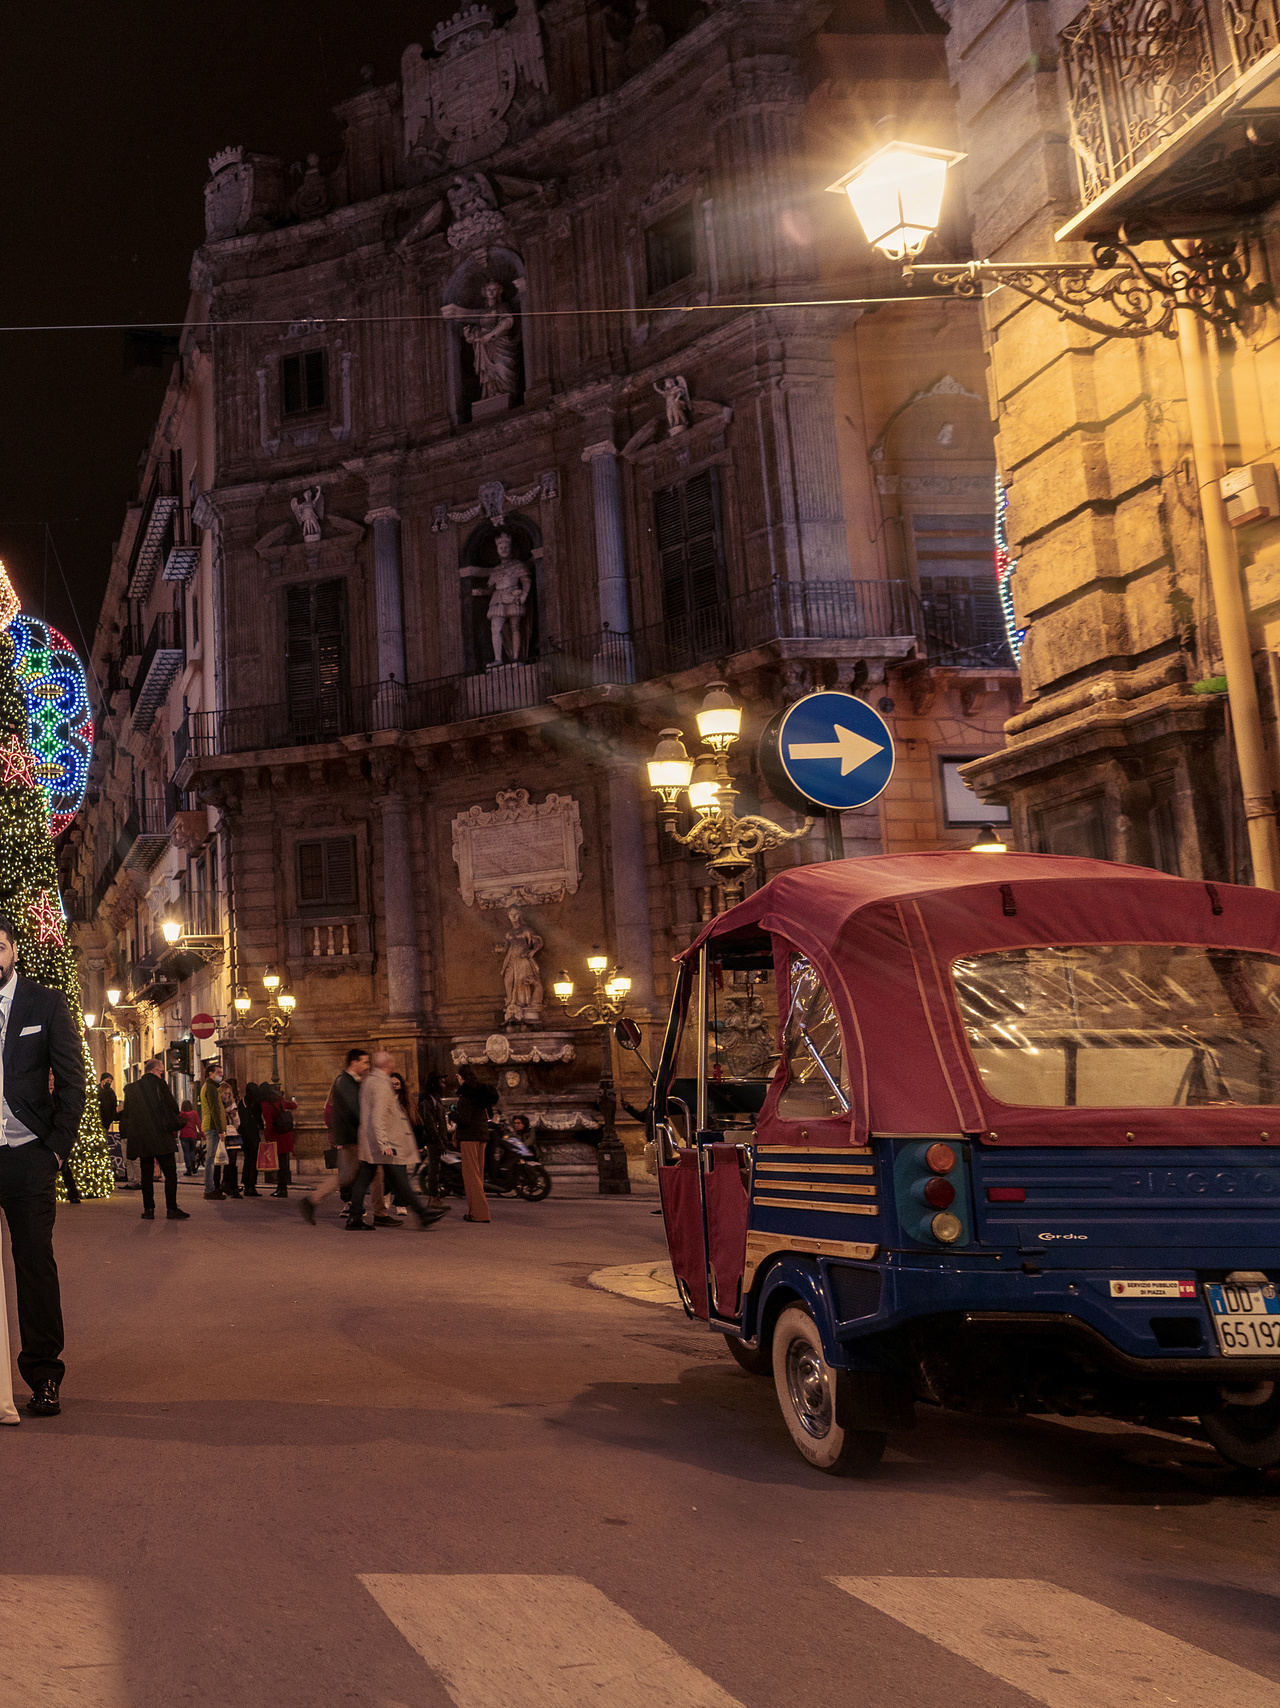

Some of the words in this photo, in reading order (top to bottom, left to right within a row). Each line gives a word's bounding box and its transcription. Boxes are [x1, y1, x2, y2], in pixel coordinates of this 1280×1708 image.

[1119, 1172, 1276, 1194] PIAGGIO
[1037, 1232, 1089, 1241] Cordio
[1225, 1287, 1253, 1312] DD
